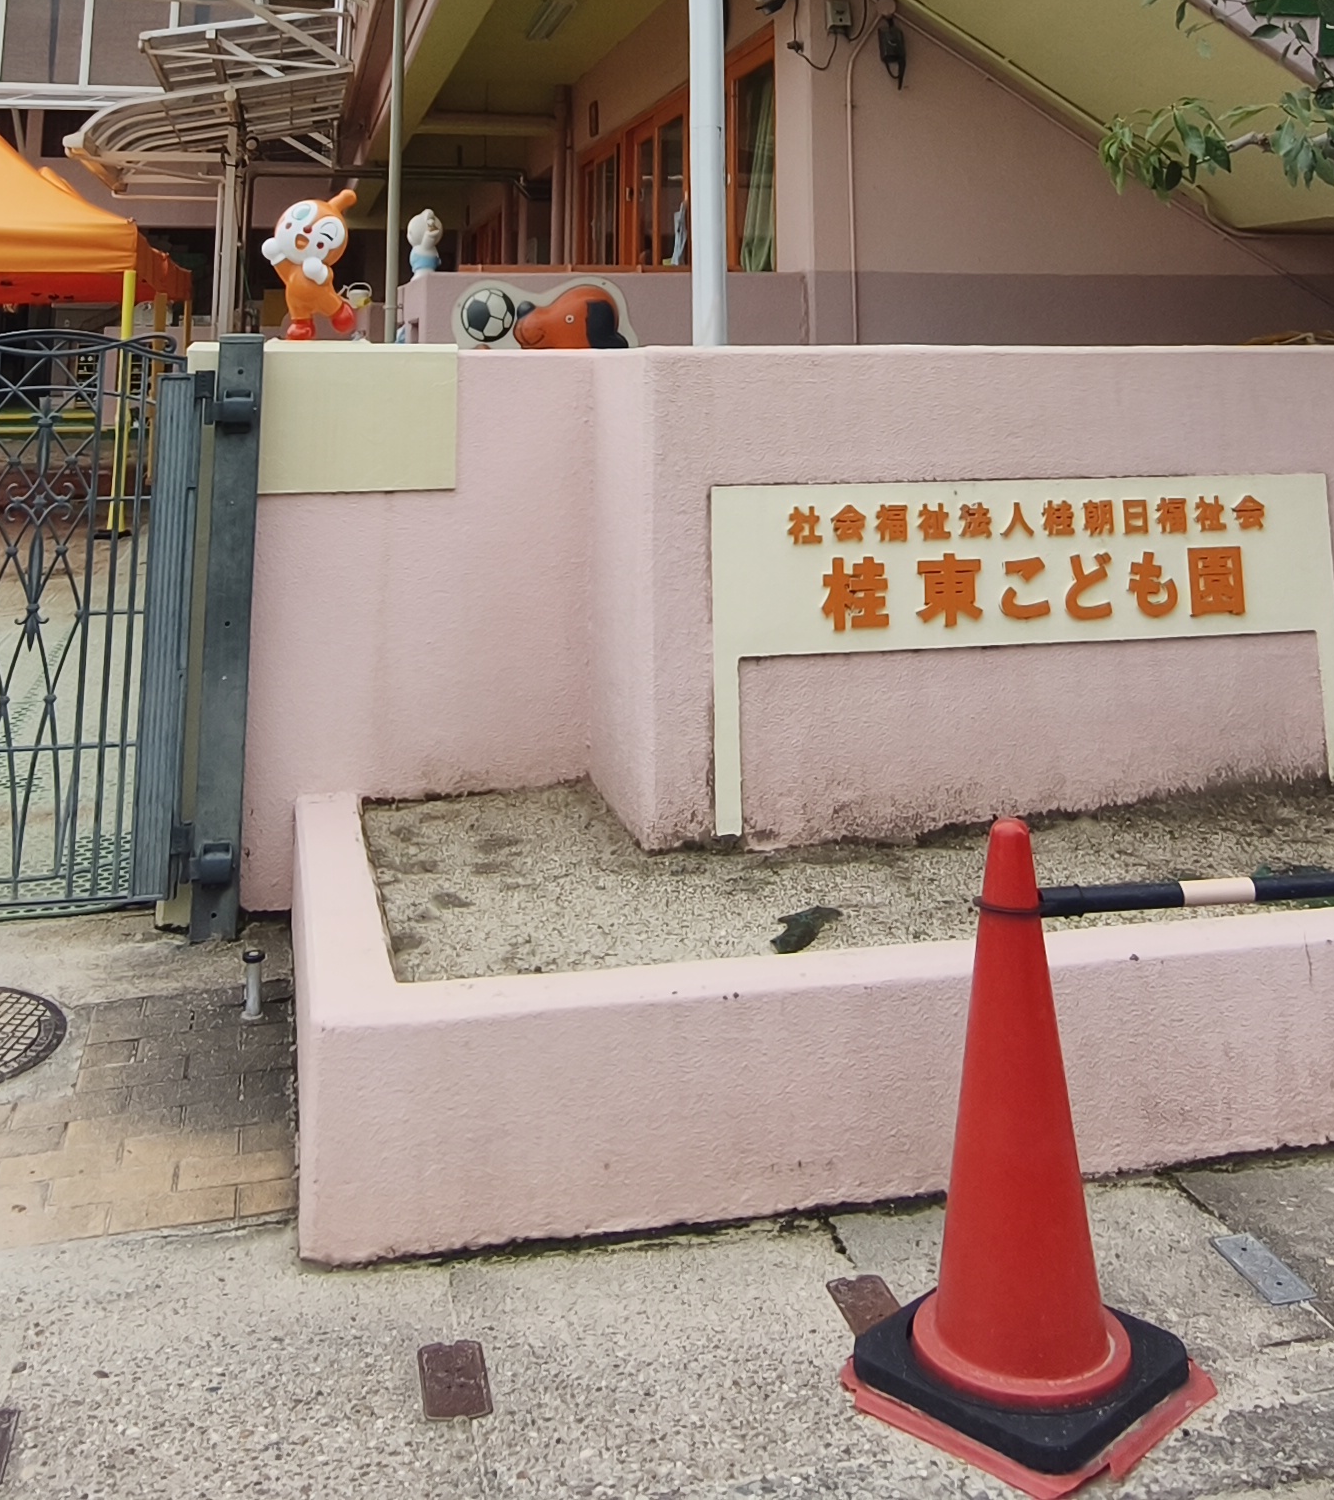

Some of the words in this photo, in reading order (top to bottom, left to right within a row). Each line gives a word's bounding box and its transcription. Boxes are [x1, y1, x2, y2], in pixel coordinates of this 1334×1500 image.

[788, 494, 1265, 545] 社会福祉法人桂朝日福祉会
[820, 546, 1247, 632] 桂東こども園
